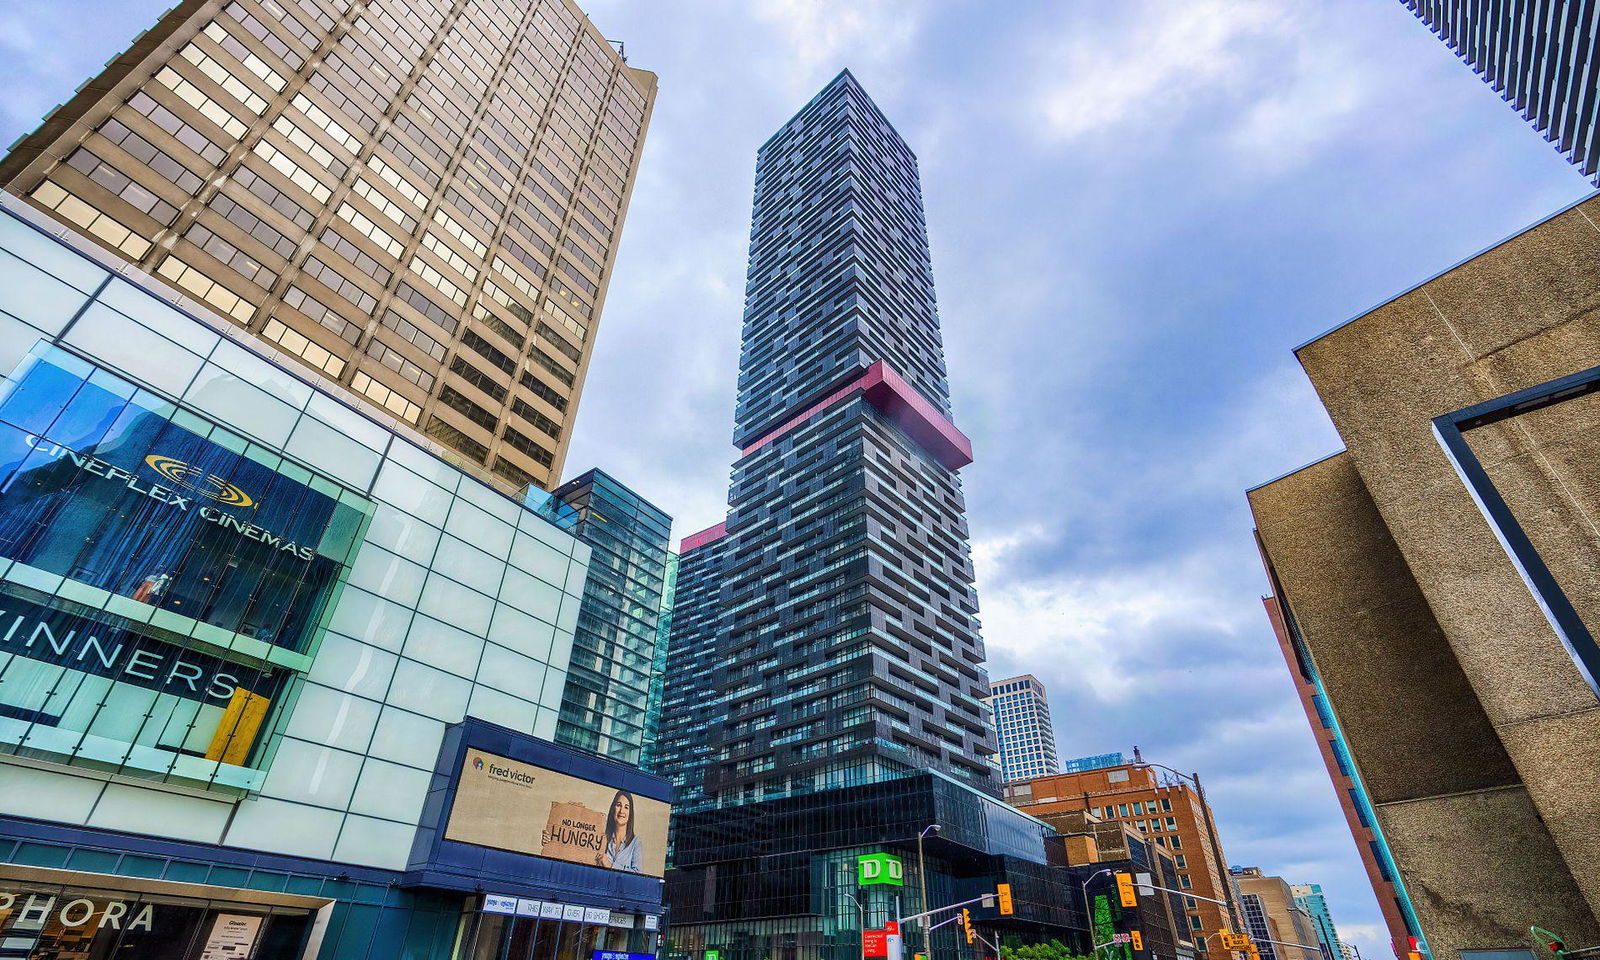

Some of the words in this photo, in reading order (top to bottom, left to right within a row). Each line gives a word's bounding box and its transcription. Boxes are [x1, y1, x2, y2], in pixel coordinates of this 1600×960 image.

[25, 433, 192, 511] CINEPLEX
[200, 507, 315, 561] CINEMAS
[0, 609, 239, 700] INNERS
[489, 763, 510, 778] fred
[510, 770, 536, 784] victor
[551, 825, 603, 851] HUNGRY
[562, 819, 572, 827] NO
[573, 821, 596, 832] LONGER
